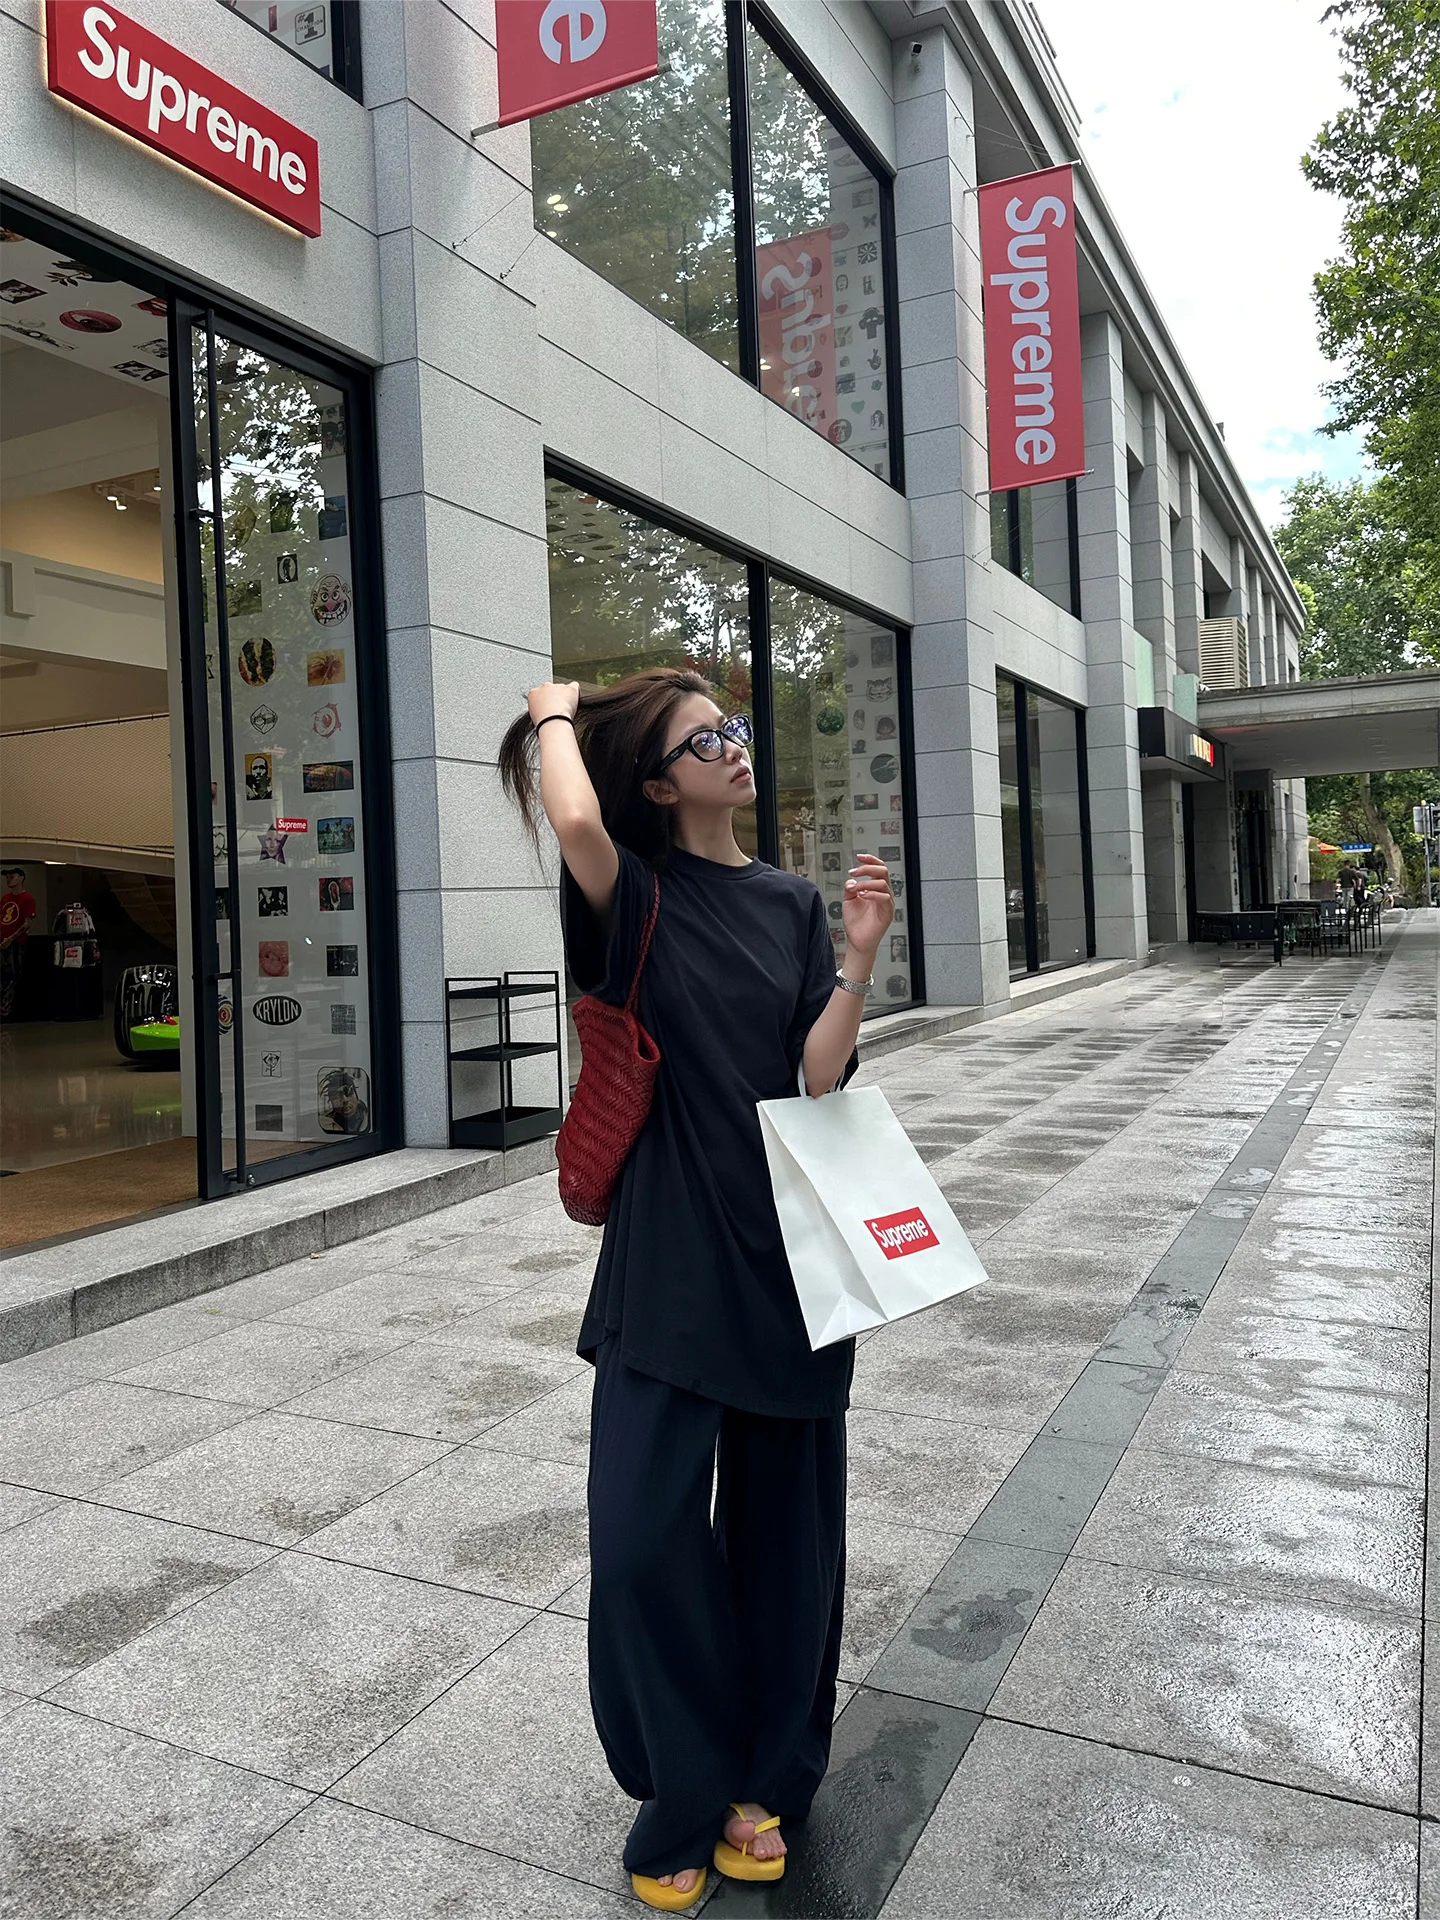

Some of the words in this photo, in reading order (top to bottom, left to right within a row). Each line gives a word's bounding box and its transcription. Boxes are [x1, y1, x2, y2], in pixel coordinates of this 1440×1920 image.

[78, 6, 307, 195] Supreme
[989, 195, 1067, 466] Supreme
[278, 818, 307, 831] Supreme
[255, 998, 299, 1023] KRYLON
[871, 1218, 929, 1253] Supreme
